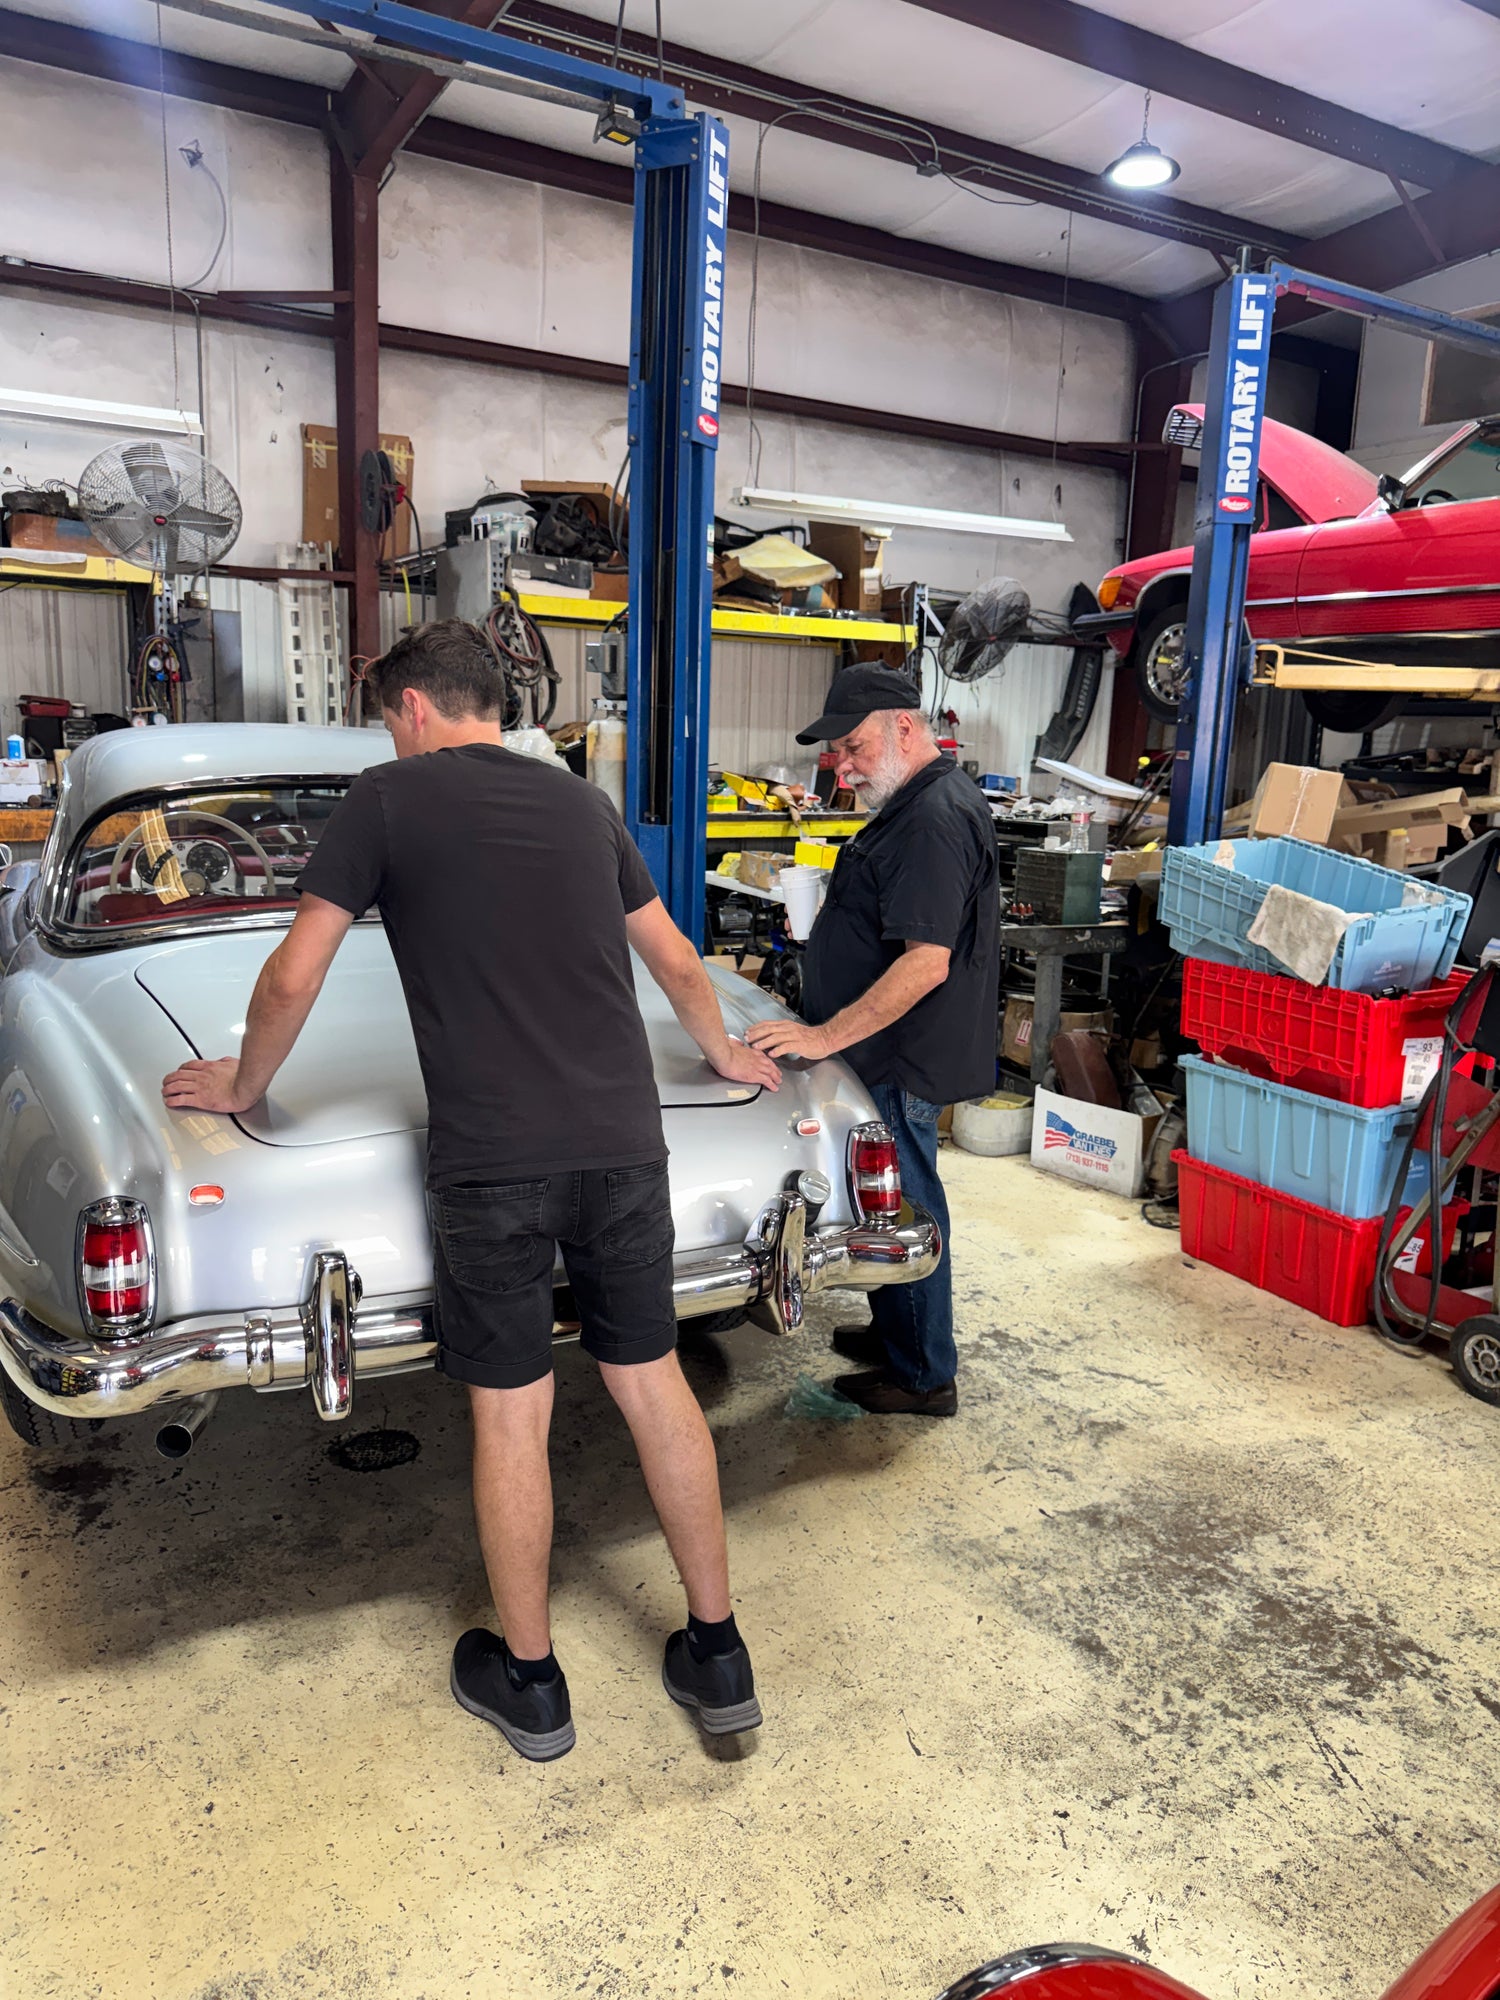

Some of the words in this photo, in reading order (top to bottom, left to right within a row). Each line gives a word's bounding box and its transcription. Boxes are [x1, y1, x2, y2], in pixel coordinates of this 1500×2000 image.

[707, 128, 726, 229] LIFT
[701, 234, 722, 413] ROTARY
[1237, 279, 1267, 350] LIFT
[1225, 360, 1259, 493] ROTARY
[1073, 1138, 1088, 1152] VAN
[1088, 1143, 1112, 1159] LINES
[1075, 1131, 1118, 1149] GRAEBEL
